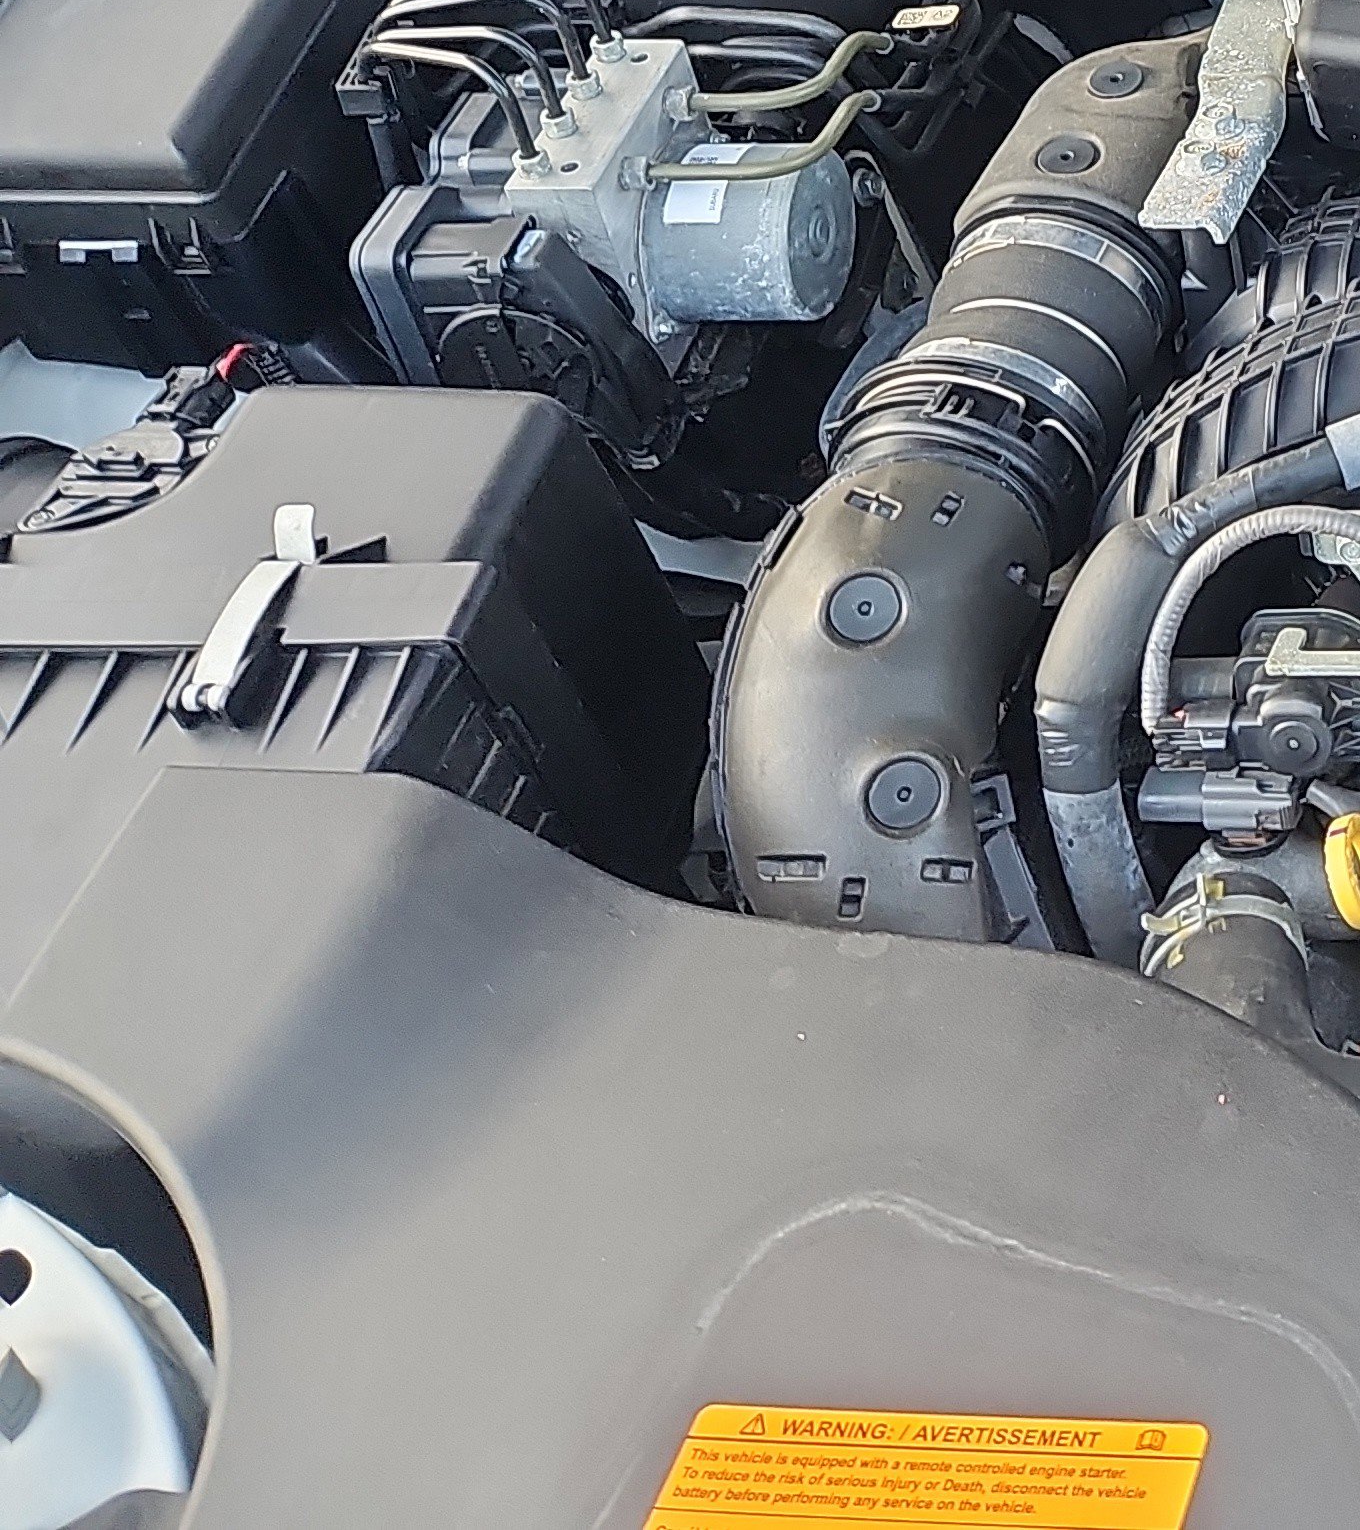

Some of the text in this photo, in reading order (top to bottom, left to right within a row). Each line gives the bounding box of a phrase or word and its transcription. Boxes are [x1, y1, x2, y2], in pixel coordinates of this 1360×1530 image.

[782, 1419, 1102, 1448] WARNING: / AVERTISSEMENT
[690, 1447, 719, 1462] This
[724, 1449, 773, 1465] vehicle
[775, 1452, 788, 1465] is
[791, 1454, 856, 1471] equipped
[860, 1456, 889, 1469] with
[891, 1459, 900, 1470] a
[904, 1459, 952, 1472] remote
[956, 1460, 1027, 1475] controlled
[1029, 1464, 1076, 1479] engine
[683, 1466, 1147, 1499] To reduce the risk of serious injury or Death, disconnect the vehicle
[672, 1486, 1037, 1514] battery before performing any service on the vehicle.
